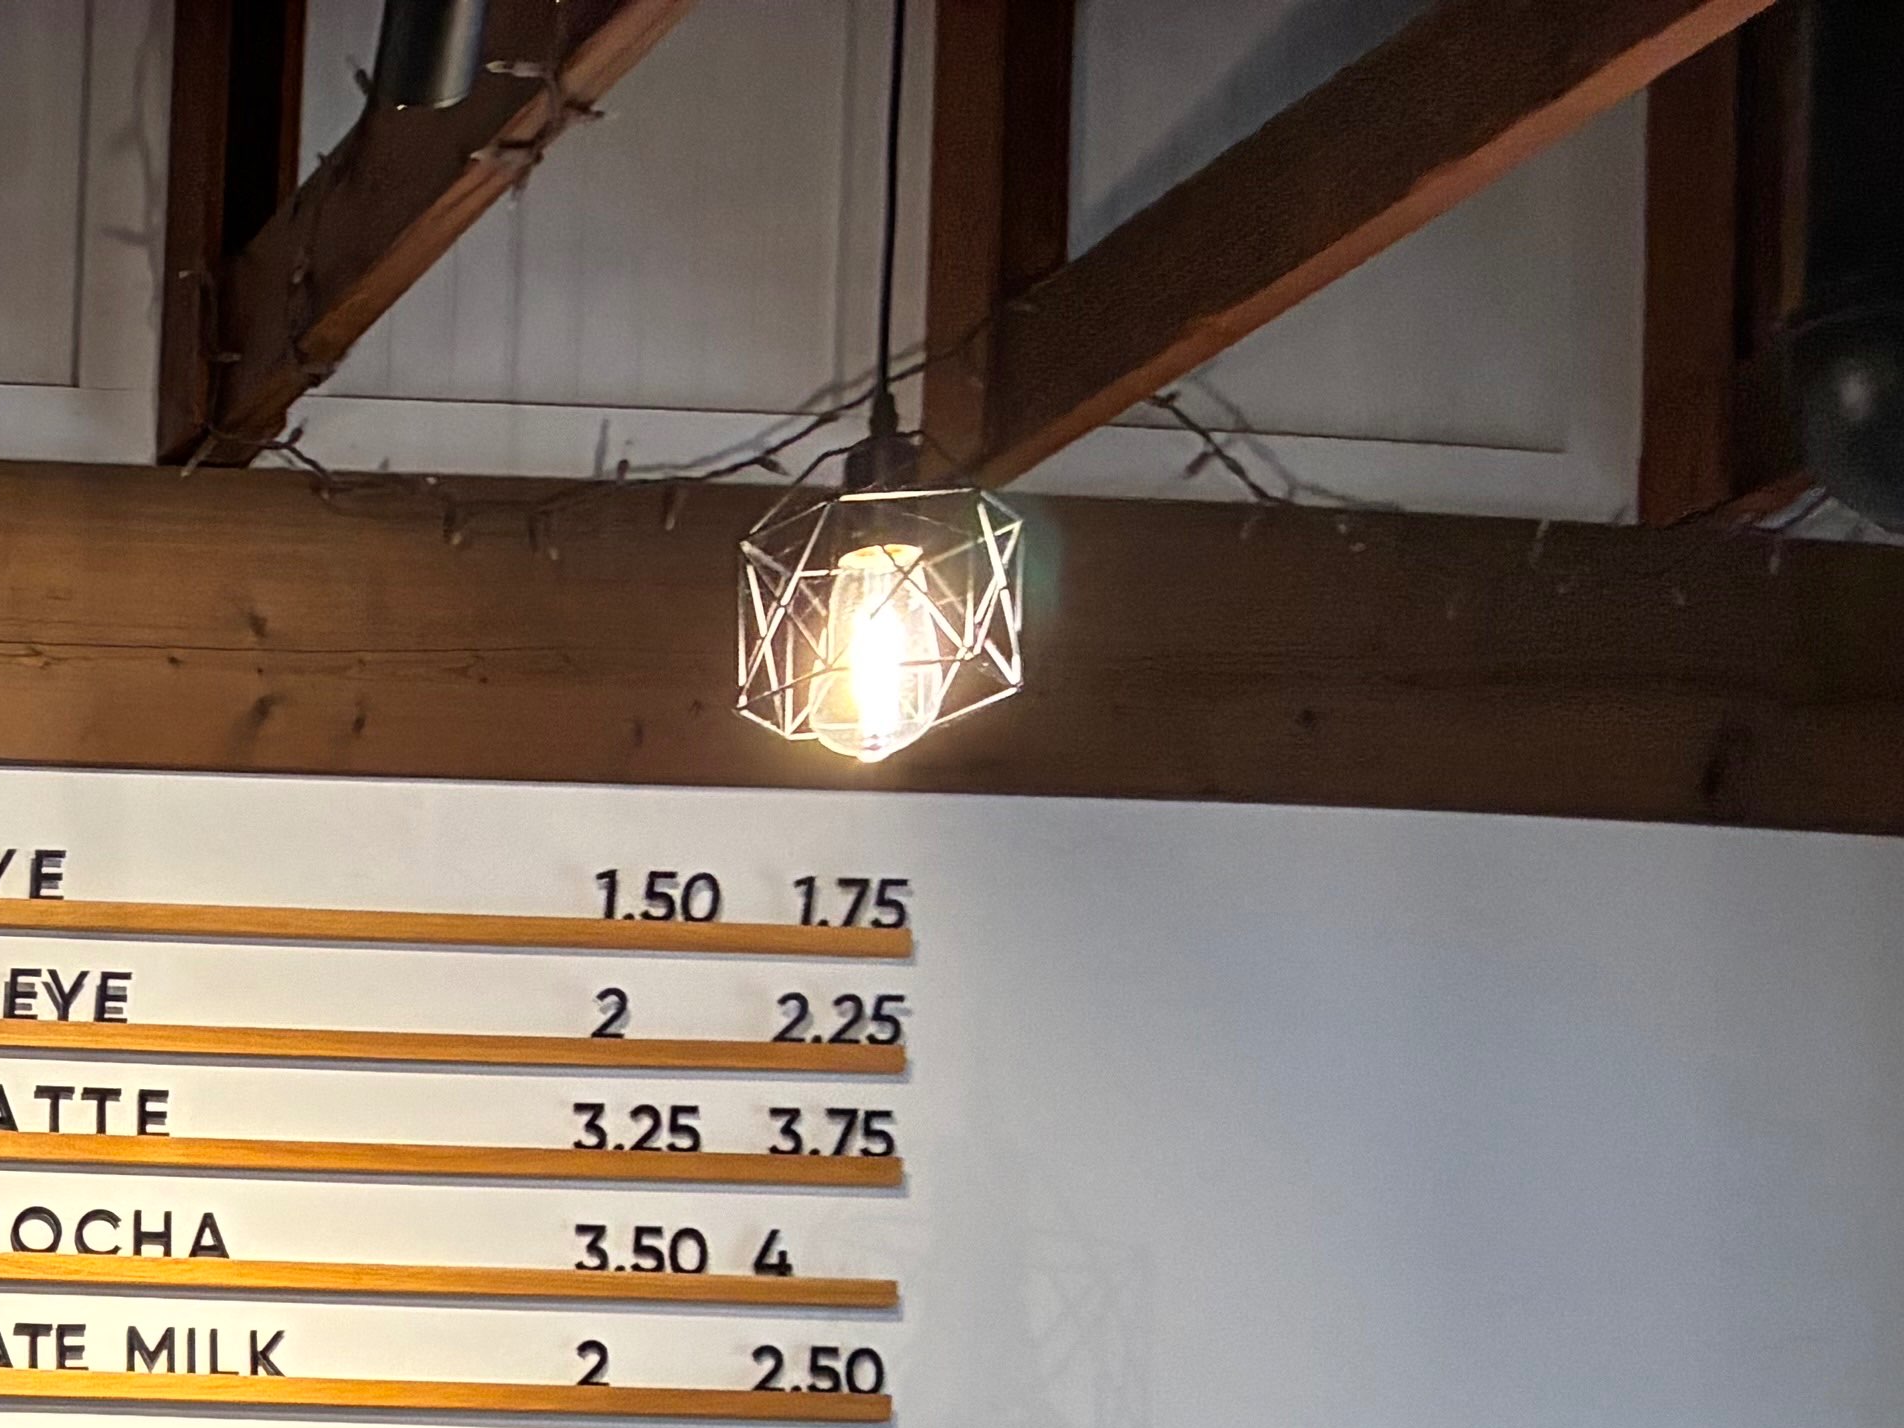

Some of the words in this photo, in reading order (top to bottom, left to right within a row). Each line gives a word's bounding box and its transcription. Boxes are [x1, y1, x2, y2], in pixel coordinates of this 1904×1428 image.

[595, 870, 721, 923] 1.50
[793, 876, 911, 929] 1.75
[4, 967, 132, 1023] EYE
[592, 987, 628, 1039] 2
[772, 992, 905, 1044] 2.25
[572, 1102, 701, 1152] 3.25
[768, 1107, 894, 1157] 3.75
[574, 1224, 709, 1275] 3.50
[753, 1229, 792, 1277] 4
[126, 1325, 288, 1377] MILK
[575, 1340, 610, 1387] 2
[751, 1345, 885, 1394] 2.50
